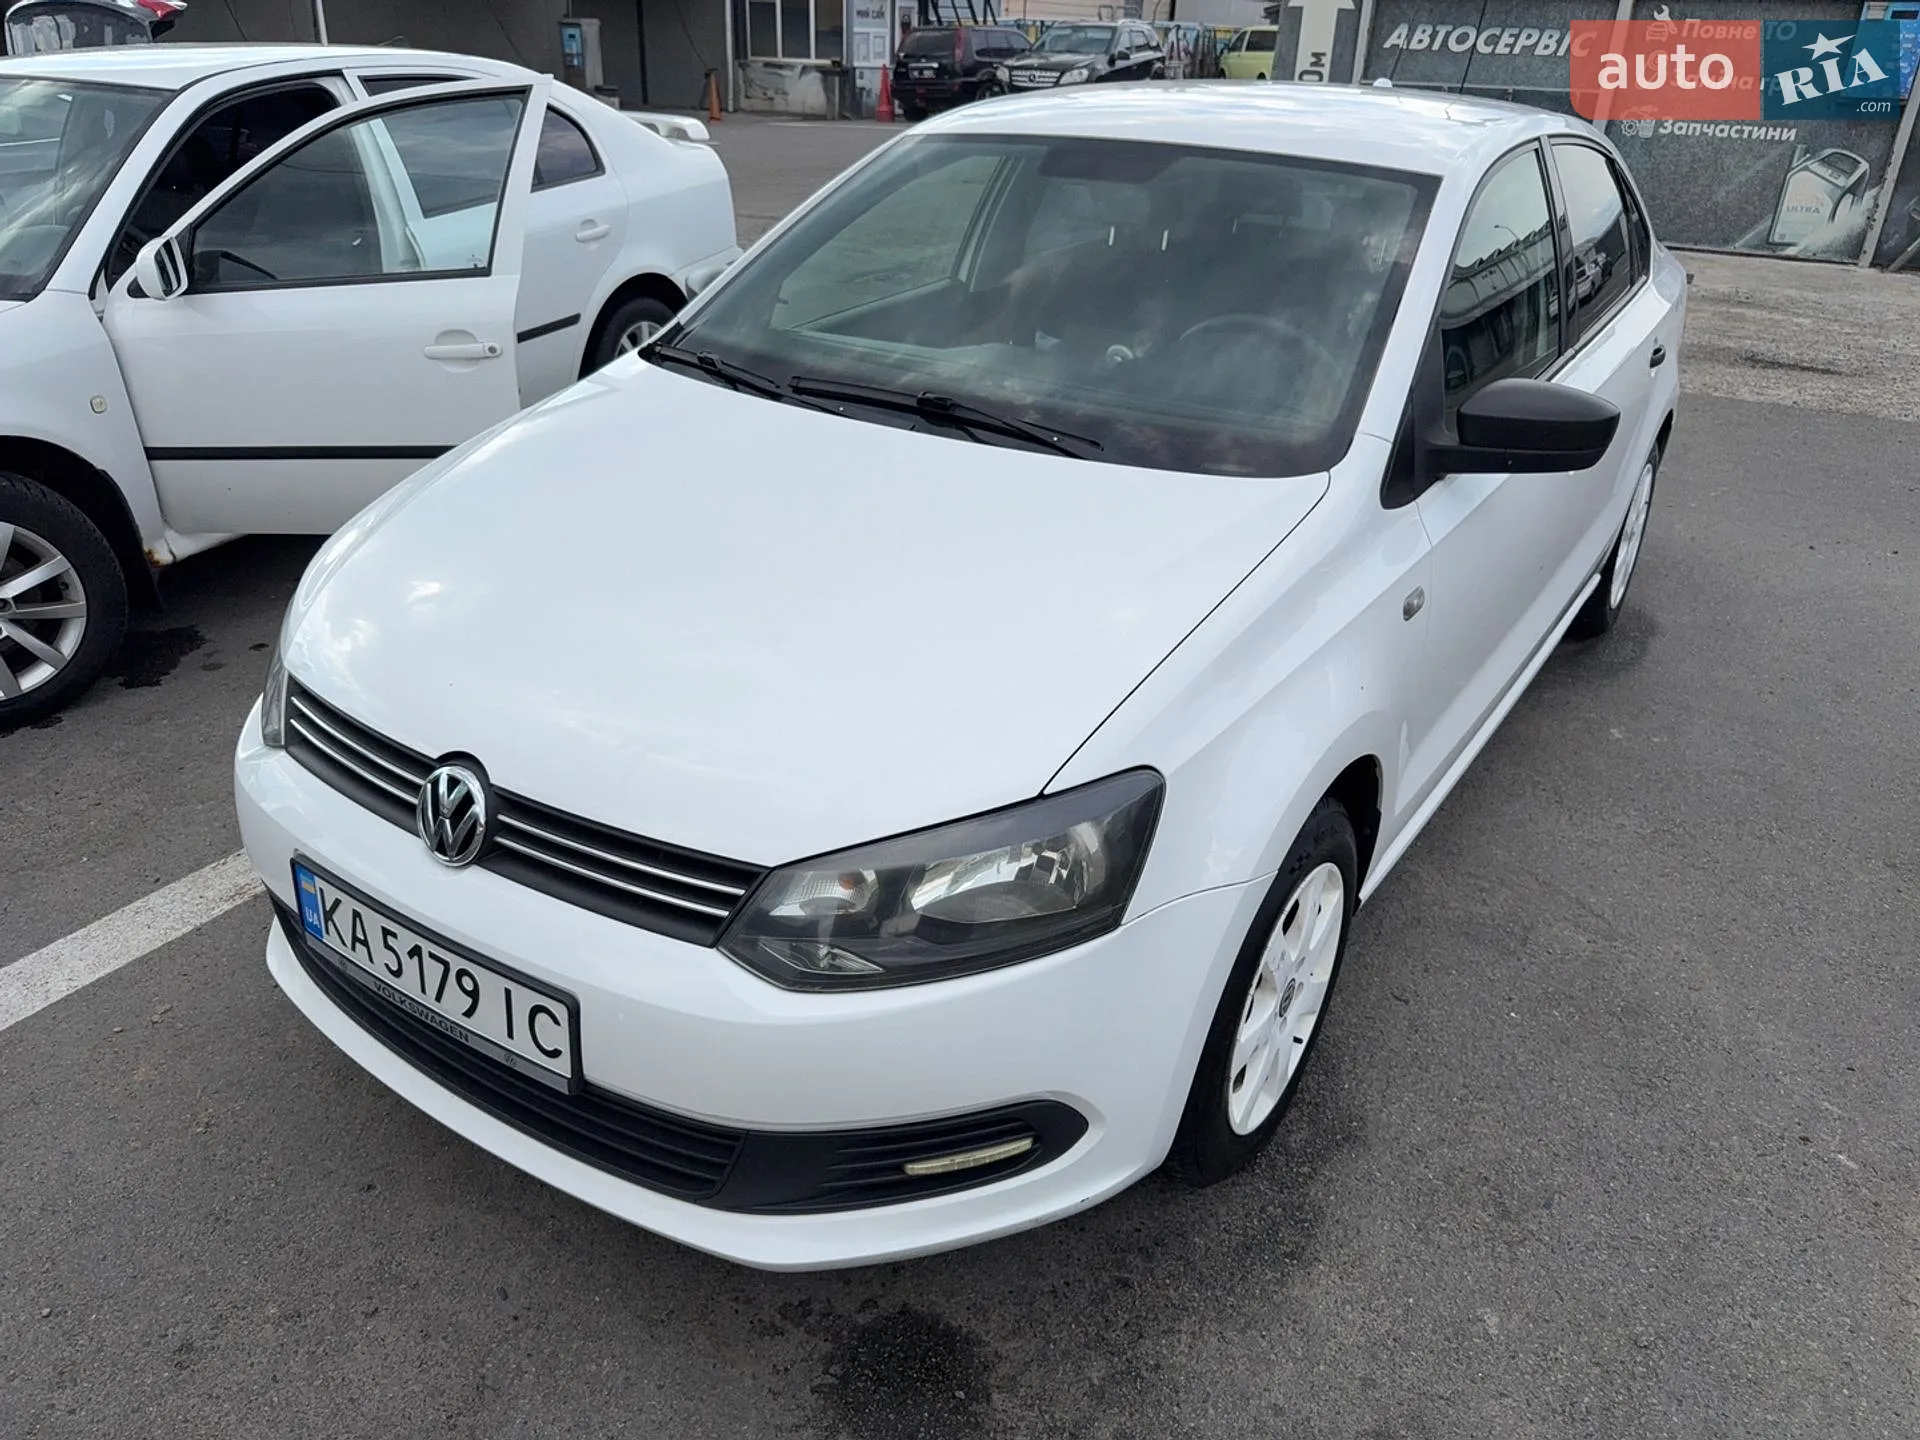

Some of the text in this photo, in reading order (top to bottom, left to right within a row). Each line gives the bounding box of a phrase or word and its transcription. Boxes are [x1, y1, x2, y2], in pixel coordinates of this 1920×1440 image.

[1383, 23, 1598, 58] АВТОСЕРВІС
[1658, 116, 1798, 142] Запчастини
[304, 906, 321, 929] UA
[319, 886, 563, 1058] KA 5179 IC
[373, 980, 471, 1044] VOLKSWAGEN
